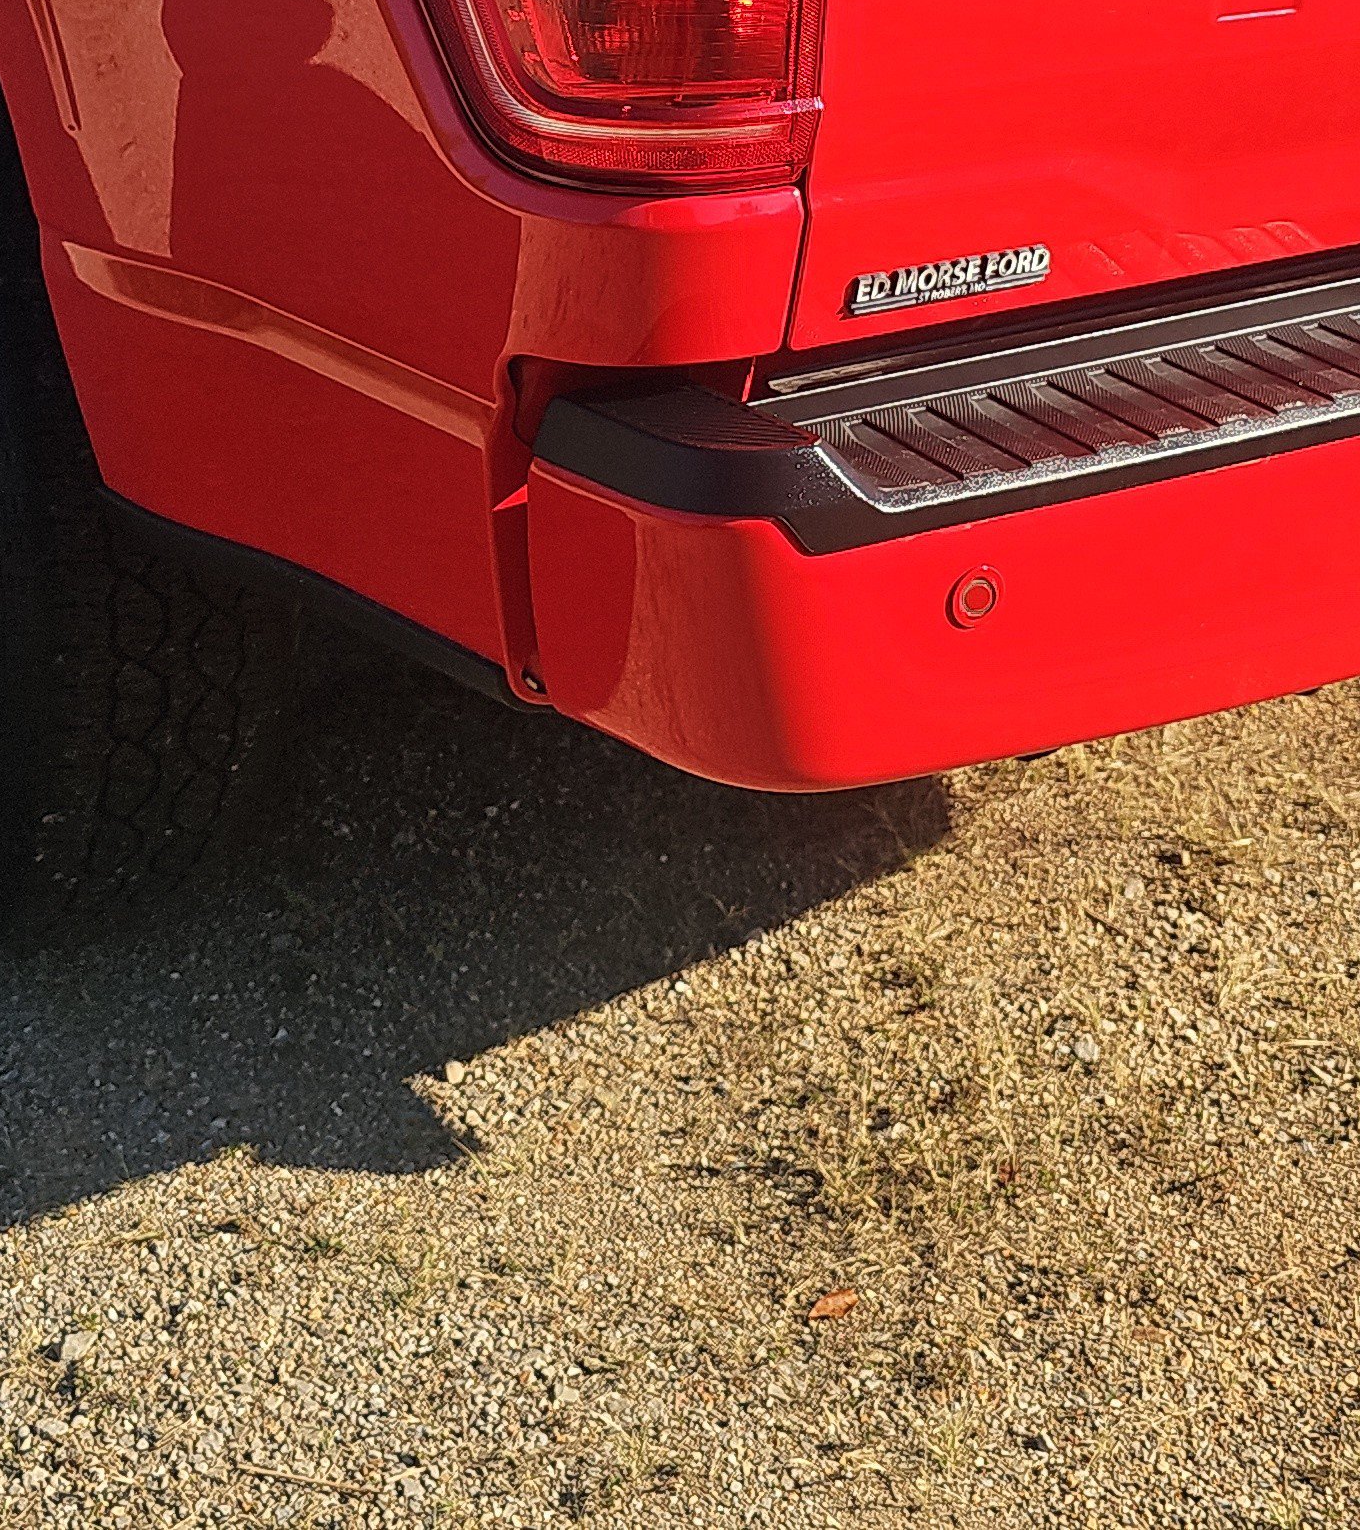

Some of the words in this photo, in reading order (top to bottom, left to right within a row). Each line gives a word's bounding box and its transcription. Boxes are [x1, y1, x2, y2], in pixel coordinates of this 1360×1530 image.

[856, 271, 890, 303] ED
[895, 255, 982, 296] MORSE
[986, 243, 1050, 278] FORD
